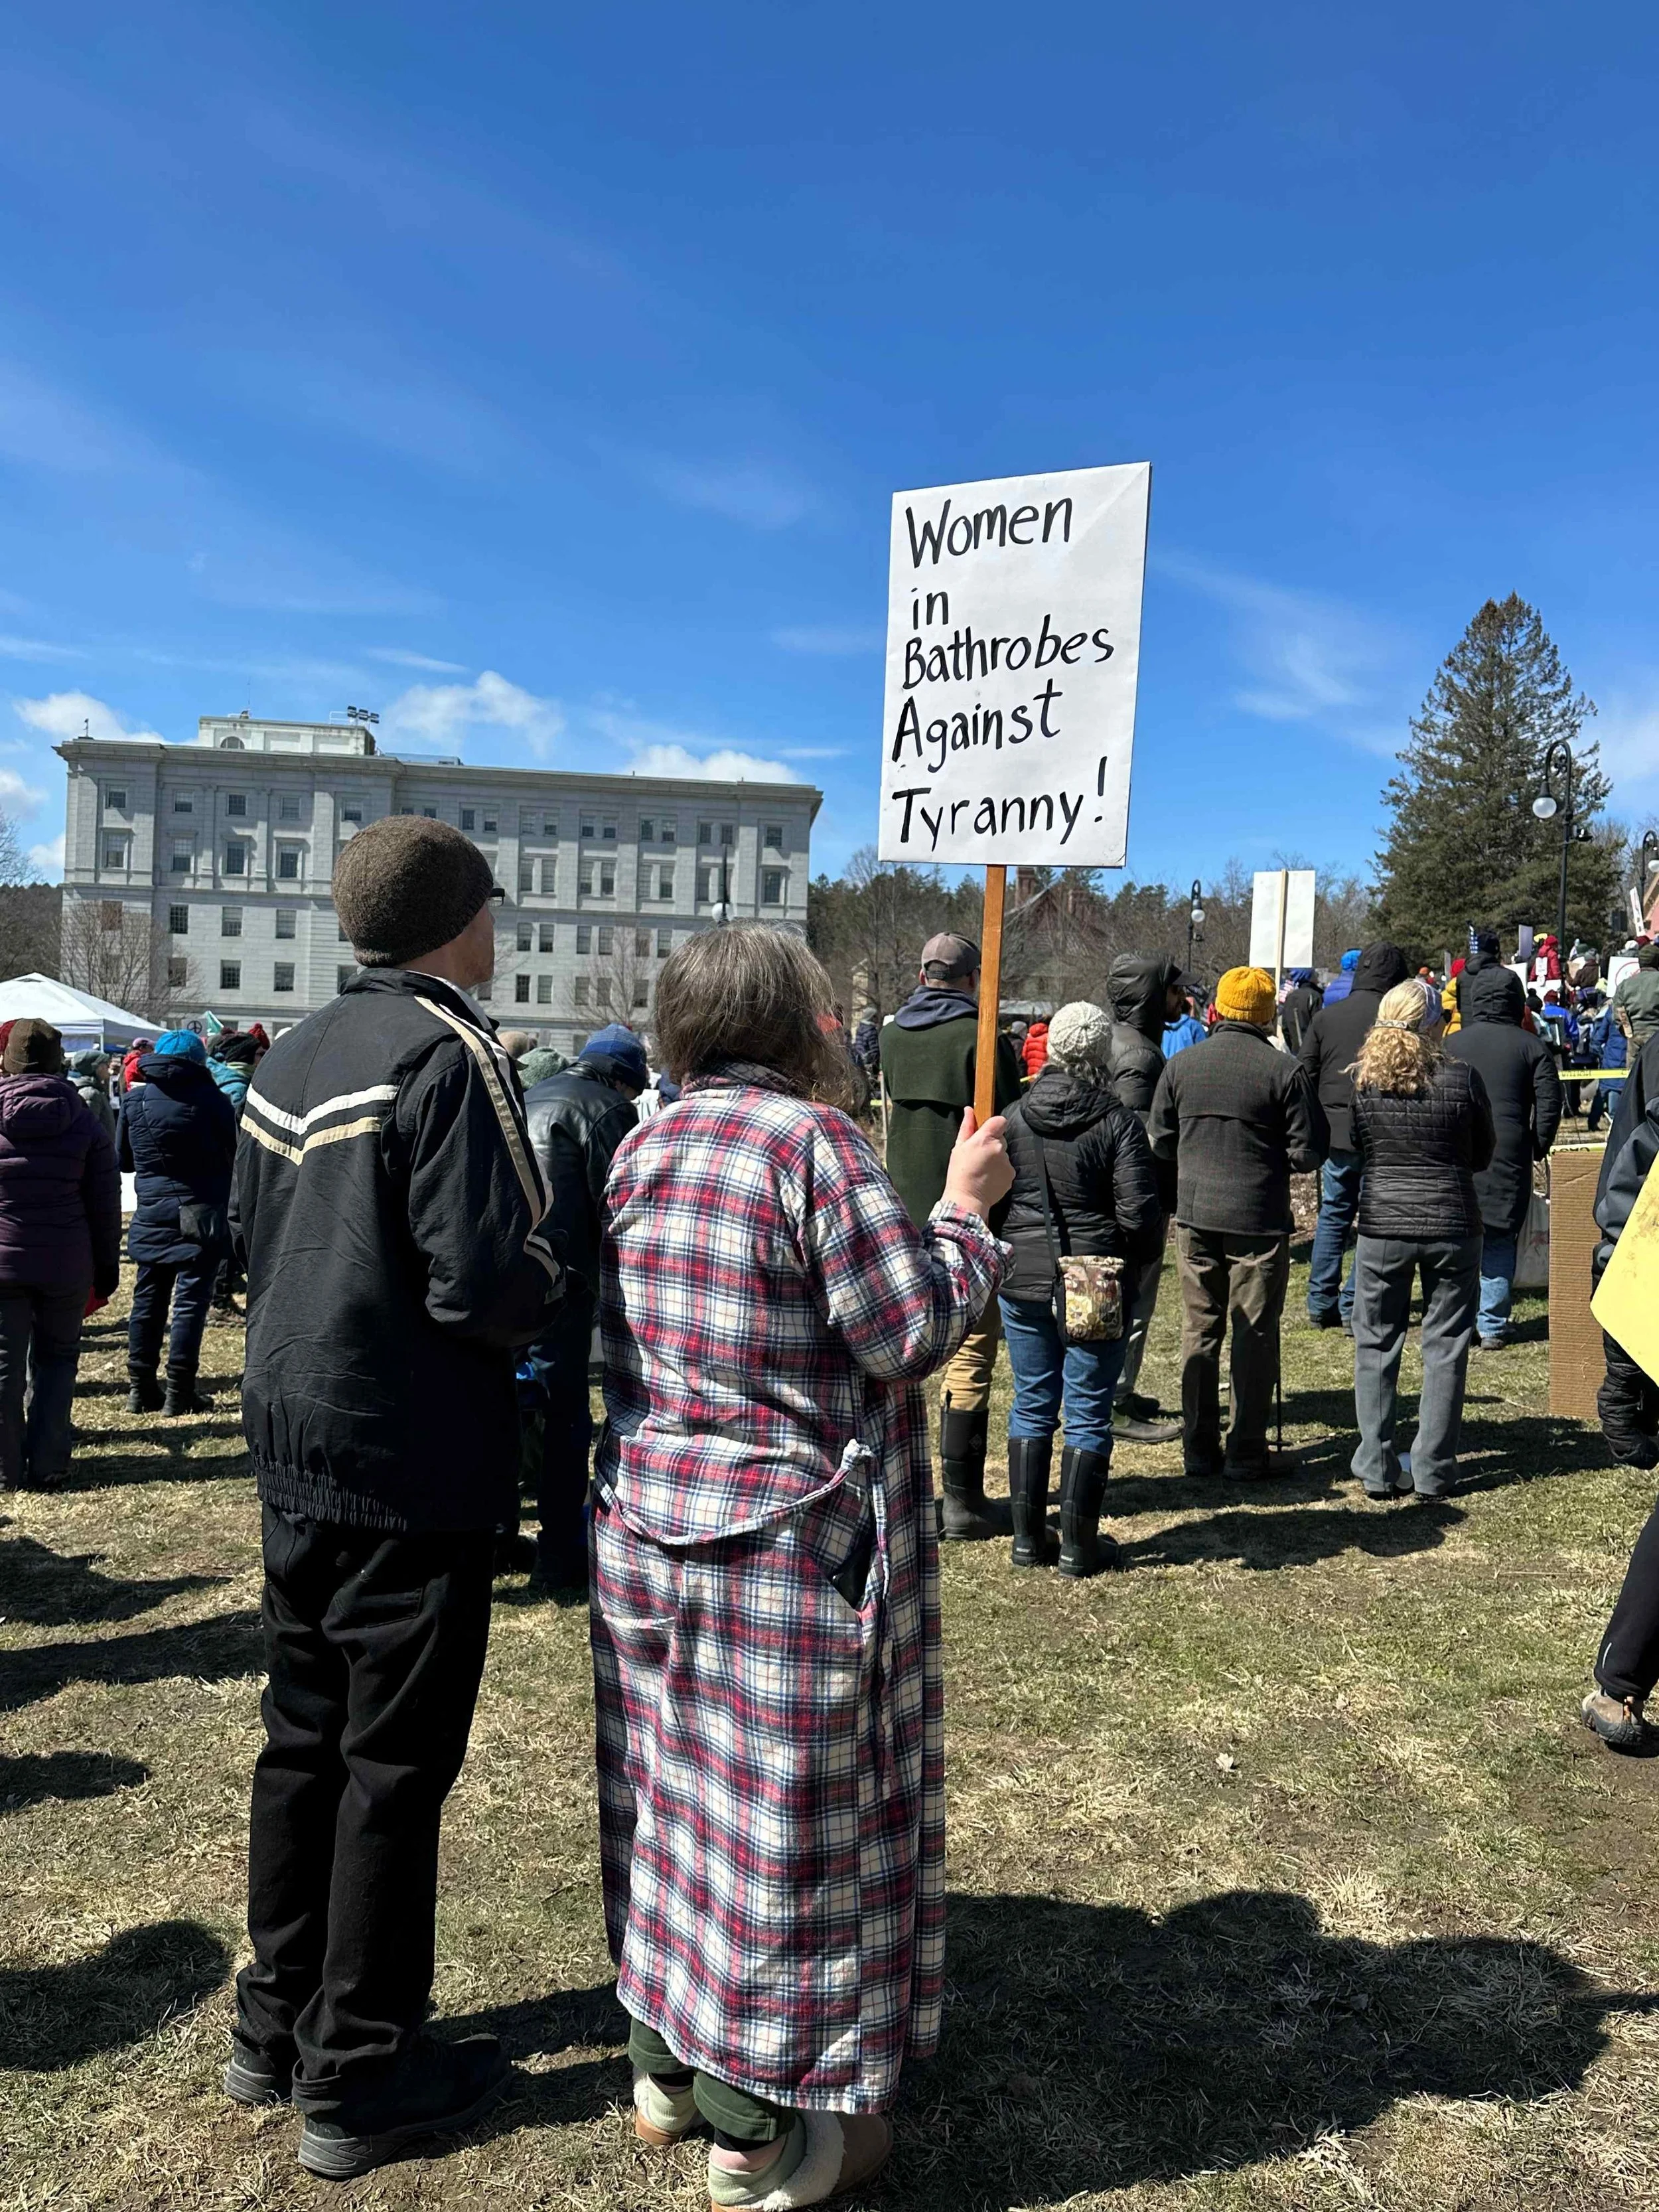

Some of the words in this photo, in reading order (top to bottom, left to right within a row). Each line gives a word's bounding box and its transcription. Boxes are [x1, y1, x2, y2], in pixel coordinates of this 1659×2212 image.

[905, 498, 1072, 569] Women
[910, 587, 949, 630] in
[902, 614, 1115, 690] Bathrobes
[891, 678, 1063, 774] Against
[891, 756, 1108, 853] Tyranny!
